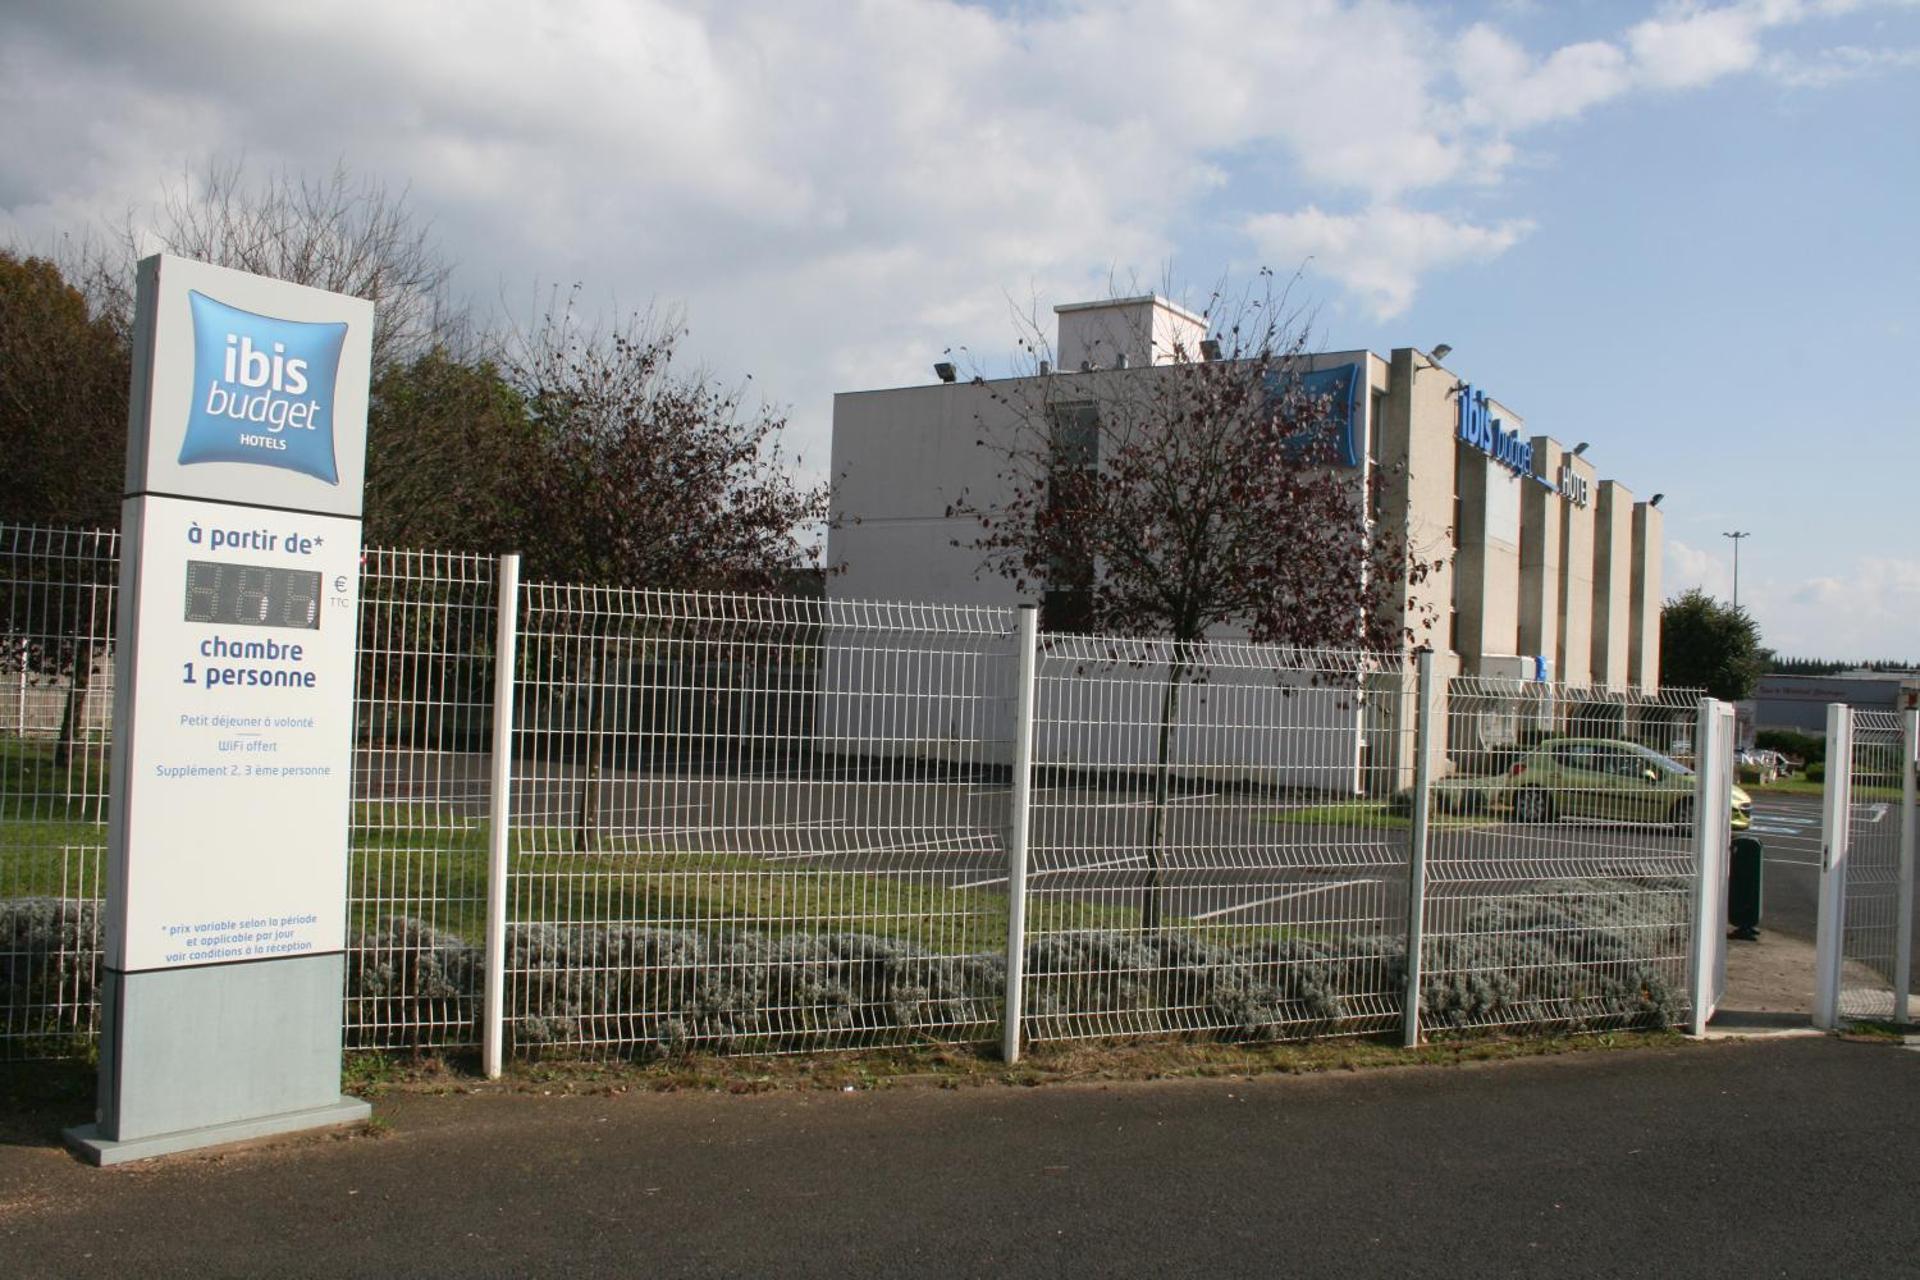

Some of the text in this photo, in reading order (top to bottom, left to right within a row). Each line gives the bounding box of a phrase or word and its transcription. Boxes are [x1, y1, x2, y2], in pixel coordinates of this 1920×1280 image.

[225, 334, 308, 394] ibis
[206, 380, 320, 432] budget
[1458, 384, 1534, 475] ibis budget
[240, 433, 287, 451] HOTELS
[187, 522, 202, 545] à
[211, 526, 278, 552] partir
[334, 575, 348, 593] €
[330, 597, 349, 609] TTC
[200, 635, 303, 661] chambre
[183, 662, 316, 690] 1 personne
[180, 714, 314, 729] Petit déjeuner à volonté
[218, 740, 277, 752] WiFi offert
[282, 766, 331, 778] personne
[169, 923, 191, 936] prix
[194, 919, 236, 933] variable
[239, 917, 267, 929] selon
[269, 917, 279, 928] la
[281, 914, 318, 929] période
[186, 929, 294, 947] et applicable par jour
[166, 951, 186, 962] voir
[189, 946, 243, 961] conditions
[255, 944, 264, 954] la
